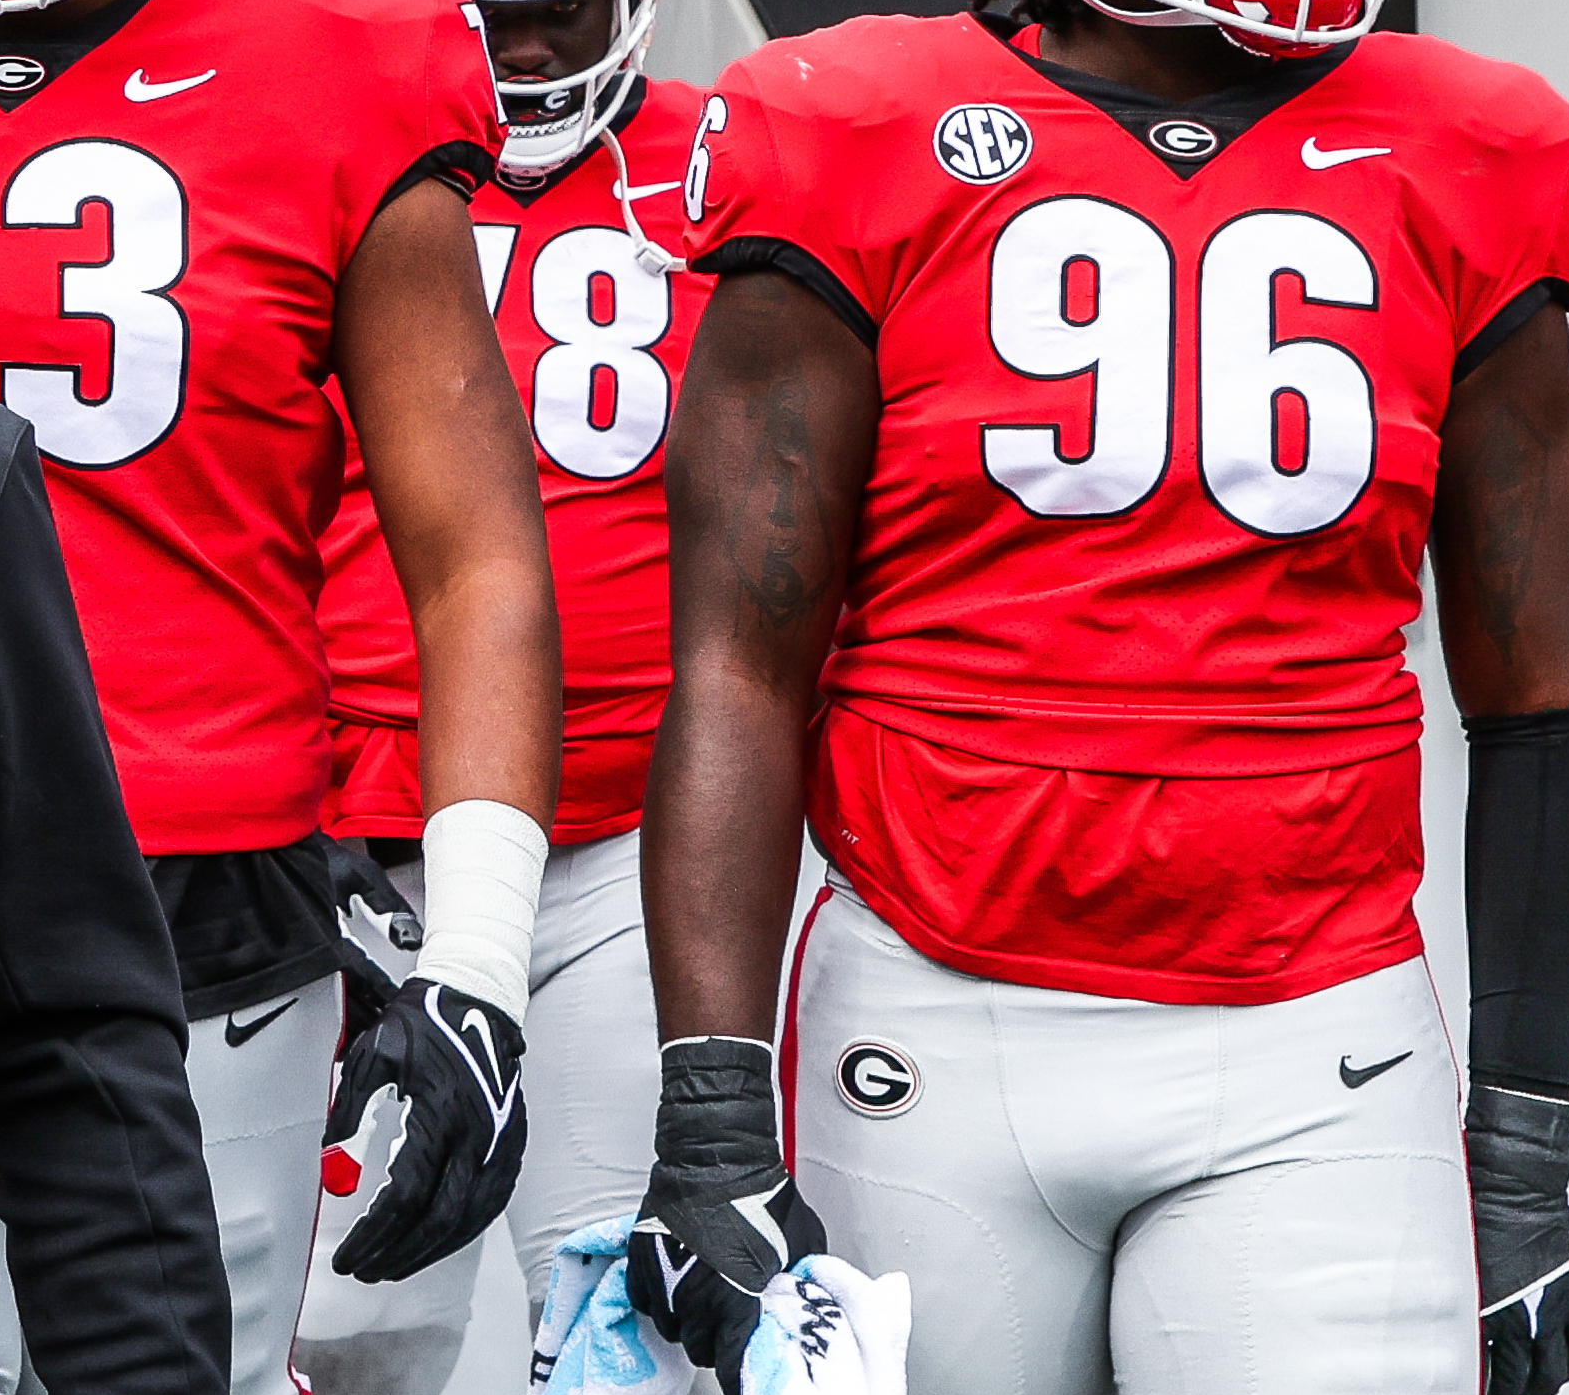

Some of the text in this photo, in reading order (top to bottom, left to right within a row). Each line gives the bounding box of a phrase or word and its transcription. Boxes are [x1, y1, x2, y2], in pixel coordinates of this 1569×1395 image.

[941, 109, 1027, 181] SEC
[980, 193, 1377, 535] 96
[833, 1040, 924, 1115] G
